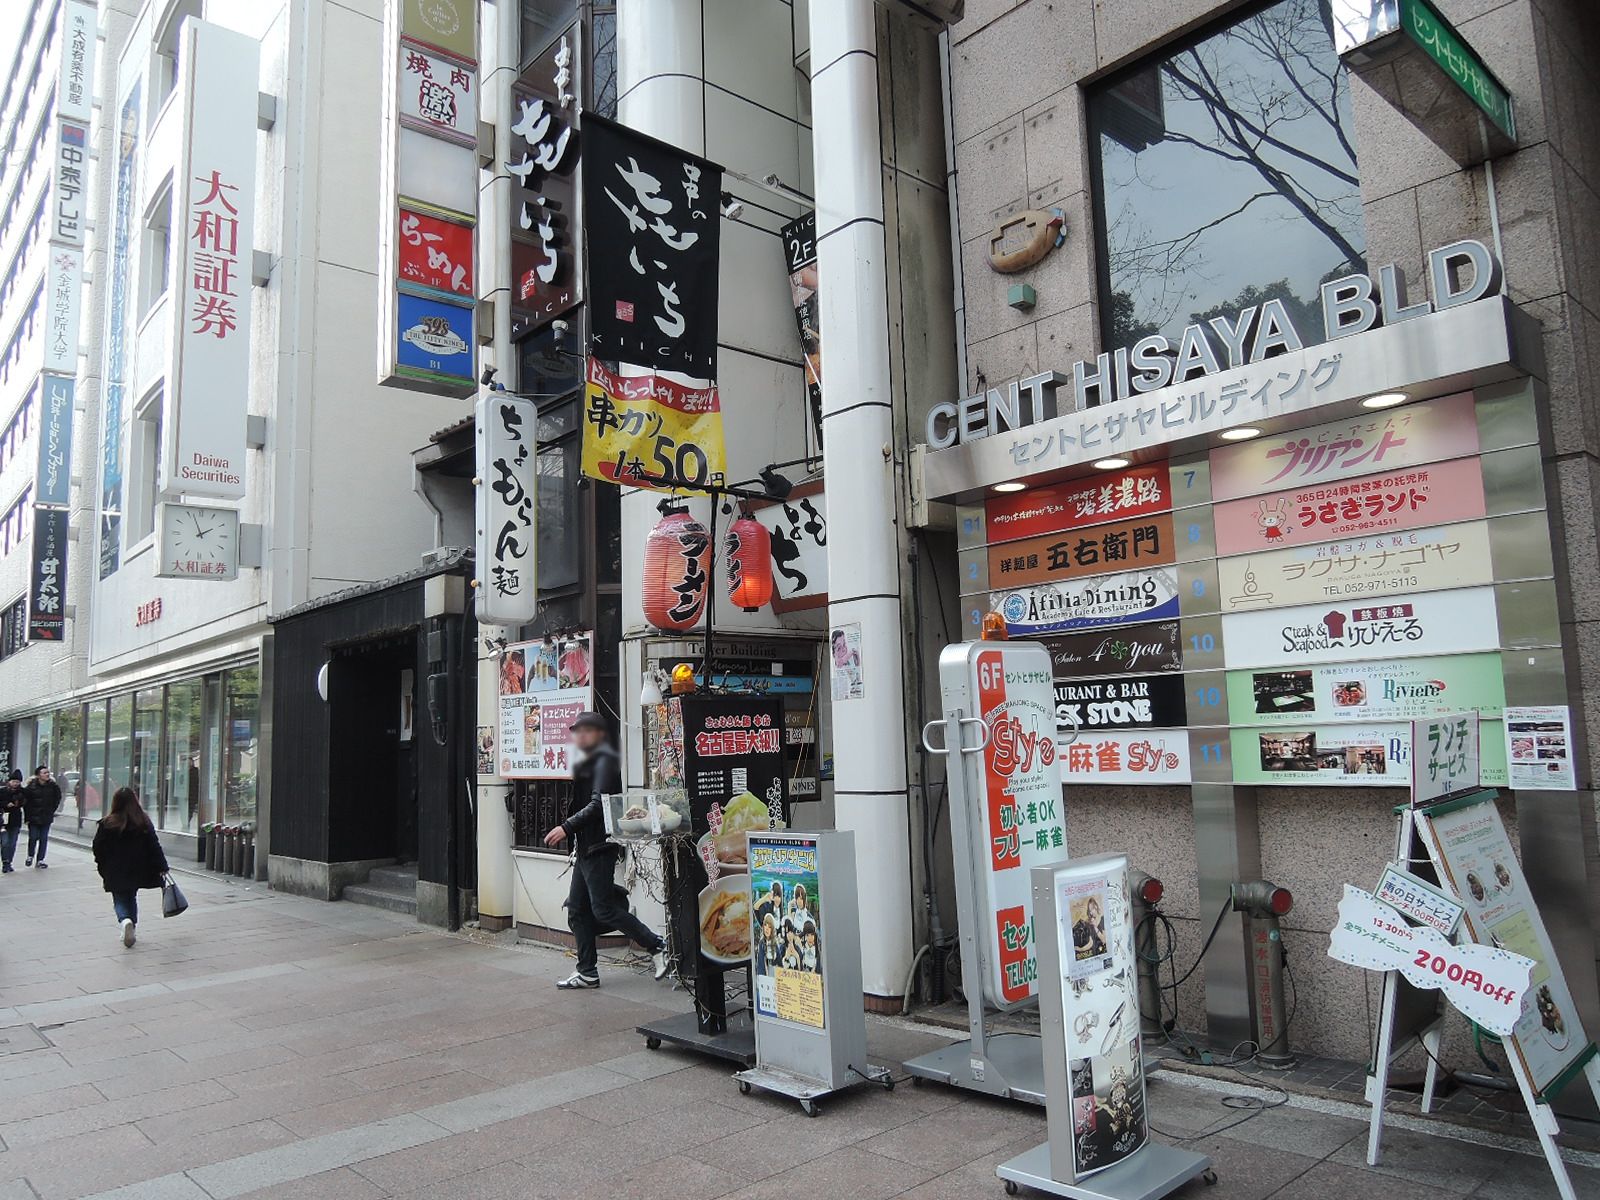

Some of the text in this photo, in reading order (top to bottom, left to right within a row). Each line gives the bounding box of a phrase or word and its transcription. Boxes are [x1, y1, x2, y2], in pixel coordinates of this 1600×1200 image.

[406, 51, 470, 93] 焼肉
[58, 147, 83, 241] 中京テレビ
[192, 170, 240, 339] 大和証券
[401, 215, 472, 291] らーめん
[789, 236, 813, 268] 2F
[926, 238, 1499, 451] CENT HISAYA BLD
[430, 359, 441, 370] B1
[587, 391, 664, 439] 串カツ
[1009, 353, 1343, 466] セントヒサヤビルディング
[193, 453, 229, 468] Daiwa
[181, 467, 241, 484] Securities
[1184, 471, 1196, 488] 7
[492, 404, 533, 598] ちょもらん麺
[1297, 485, 1430, 527] うさぎランド
[1047, 525, 1160, 571] 五右衛門
[1375, 539, 1385, 549] &
[172, 559, 227, 575] 大和証券
[667, 521, 710, 623] ラーメン
[968, 563, 979, 579] 2
[1282, 542, 1461, 581] ラクサ・ナゴヤ
[38, 557, 60, 614] 甘太郎
[1323, 576, 1418, 596] TEL 052-971-5113
[1360, 606, 1405, 620] 鉄板焼
[1190, 634, 1216, 652] 10
[1316, 623, 1327, 637] &
[688, 642, 776, 657] Toer Building
[1124, 641, 1164, 670] you
[980, 661, 1001, 690] 6F
[1004, 671, 1051, 684] セントヒサヤビル
[1106, 684, 1116, 698] &
[1121, 682, 1149, 697] BAR
[1196, 687, 1220, 706] 10
[1087, 699, 1152, 724] STONE
[695, 729, 780, 756] 名古屋最大級!!
[993, 713, 1055, 777] Style
[1428, 719, 1468, 757] ランチ
[543, 746, 568, 771] 焼肉
[1127, 738, 1180, 774] Style
[1202, 744, 1222, 762] 11
[1428, 753, 1467, 782] サービス
[1000, 800, 1056, 828] 初心者OK
[996, 828, 1063, 858] フリー麻雀
[1384, 880, 1453, 924] 雨の日サービス
